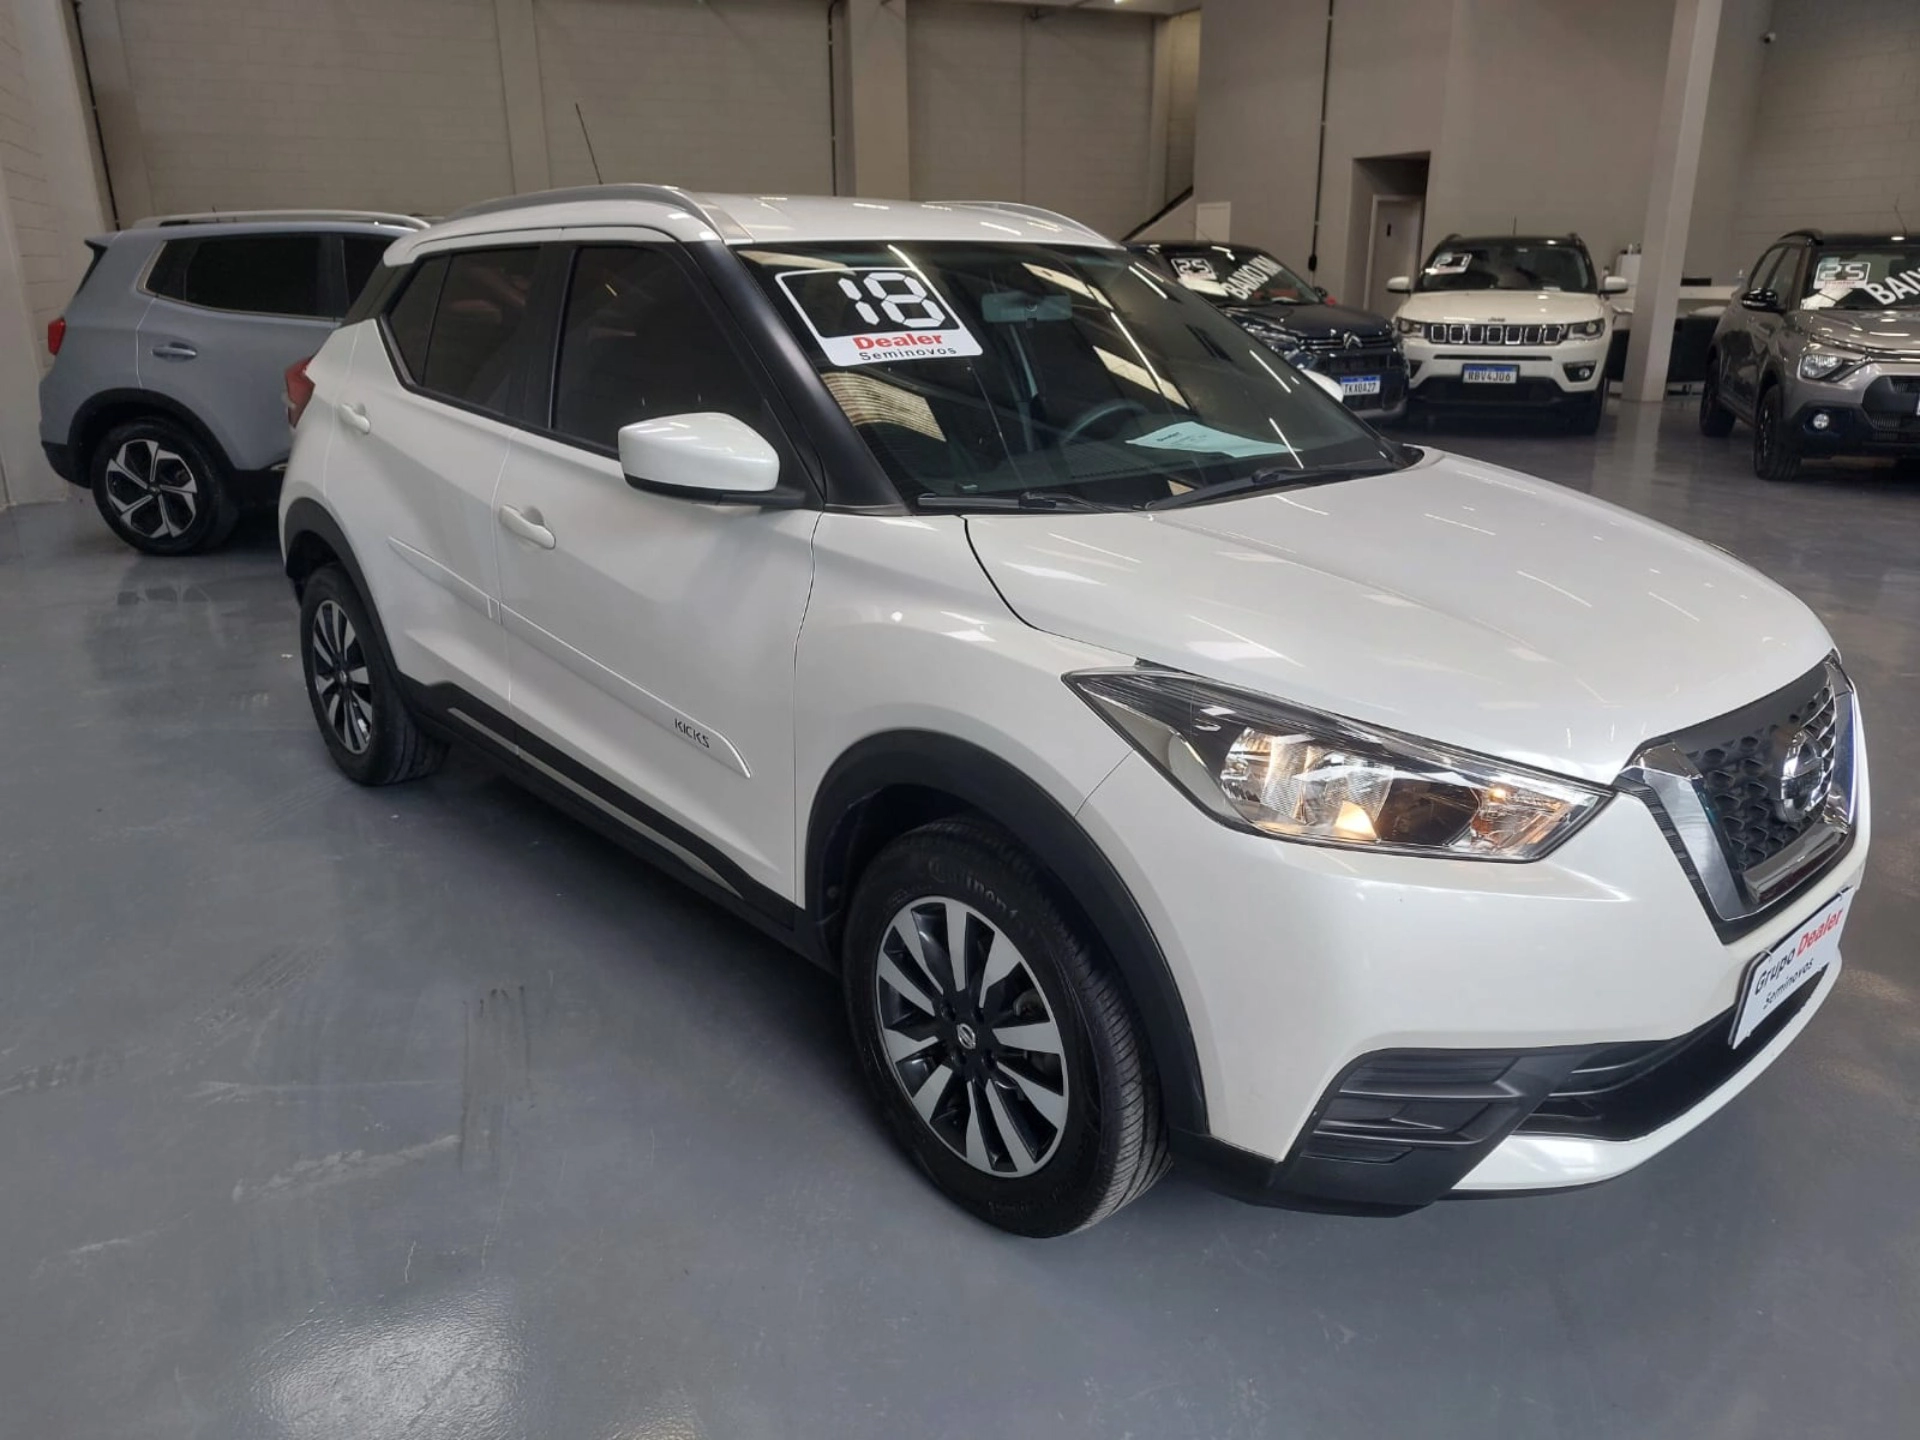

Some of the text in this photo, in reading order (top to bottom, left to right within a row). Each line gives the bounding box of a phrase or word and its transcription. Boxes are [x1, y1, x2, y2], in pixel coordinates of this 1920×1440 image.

[1176, 260, 1209, 274] 25
[1820, 264, 1864, 280] 25
[1220, 265, 1269, 300] BAIXO
[838, 272, 946, 328] 18
[852, 333, 943, 350] Dealer
[858, 346, 957, 361] Seminovos
[674, 718, 710, 748] KICKS
[1755, 908, 1843, 995] Grupo Dealer
